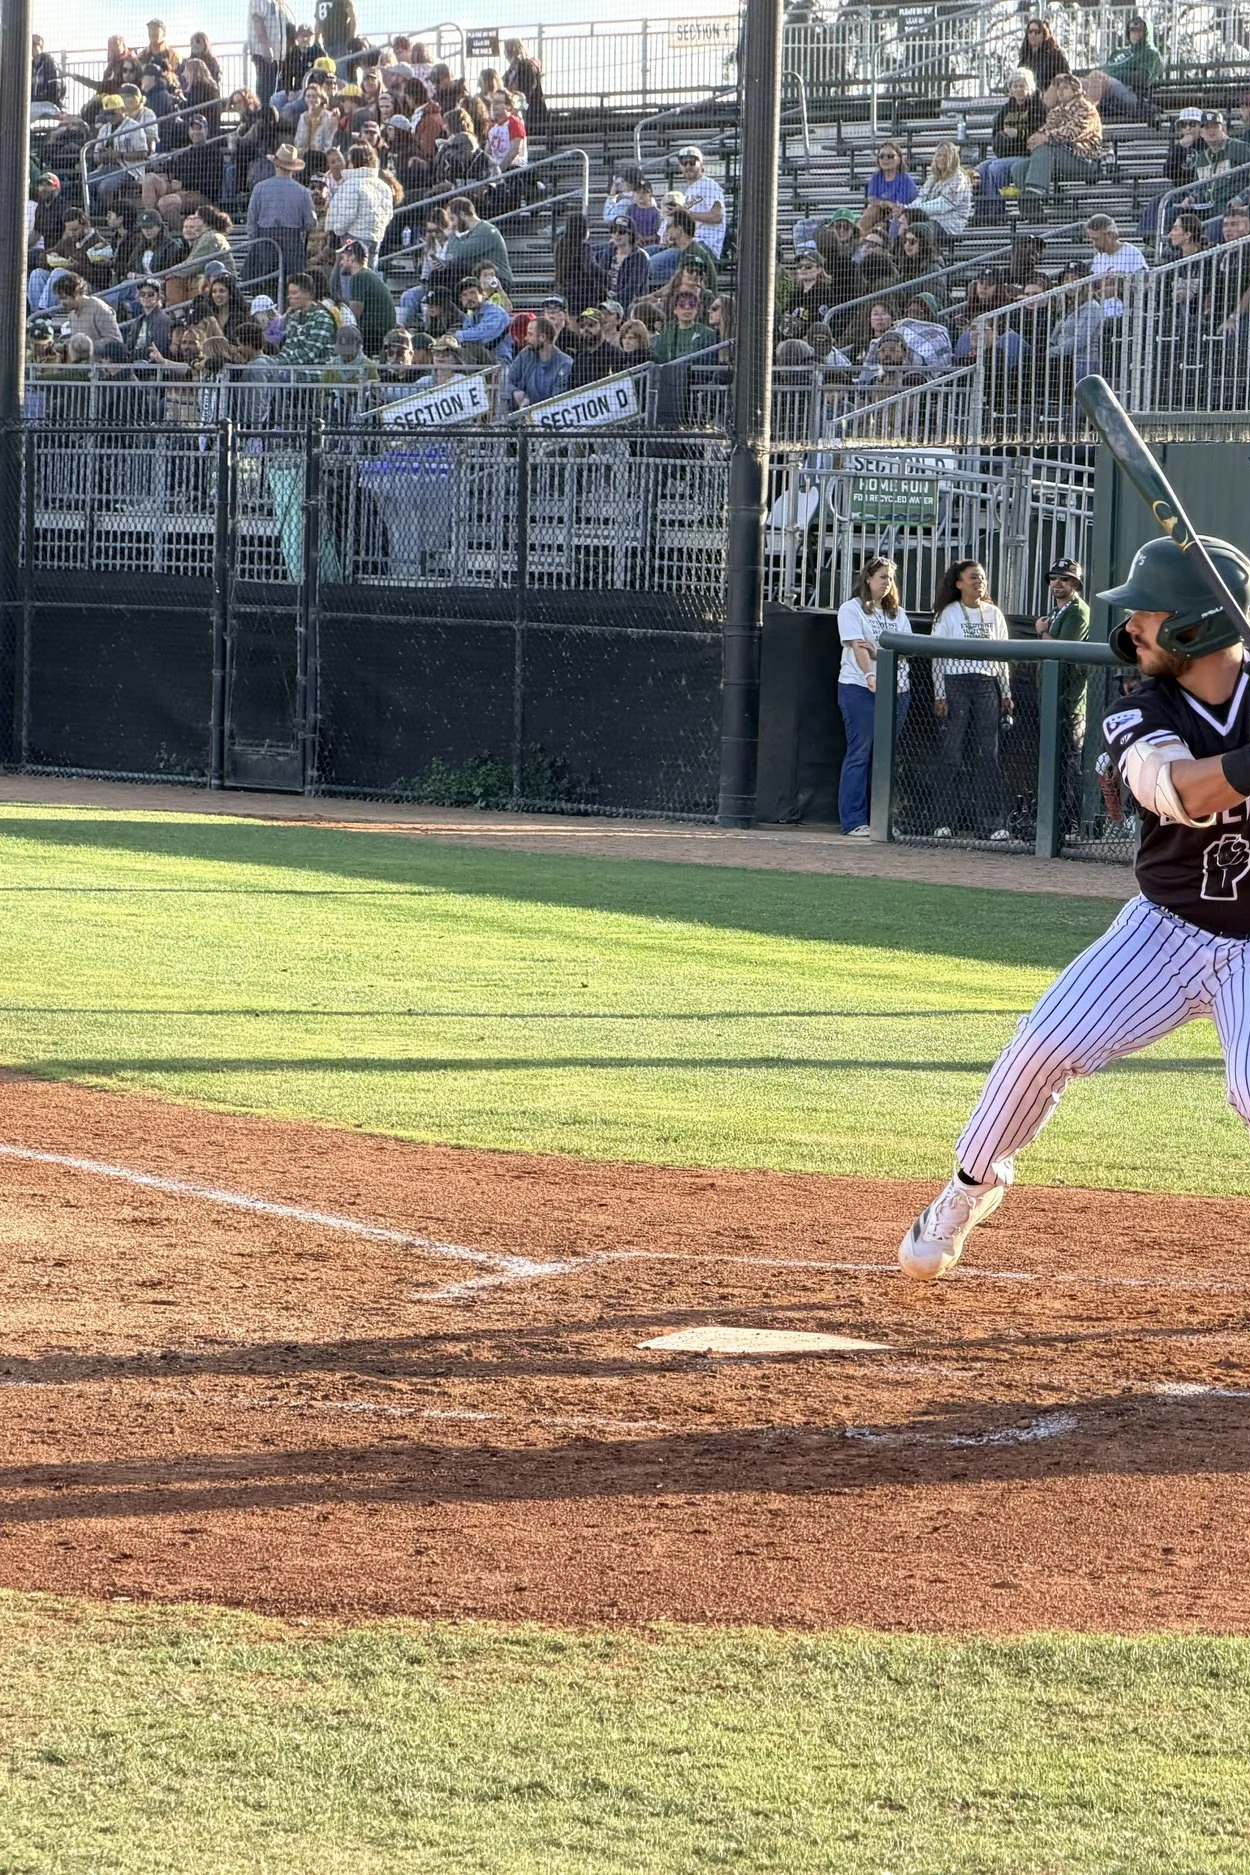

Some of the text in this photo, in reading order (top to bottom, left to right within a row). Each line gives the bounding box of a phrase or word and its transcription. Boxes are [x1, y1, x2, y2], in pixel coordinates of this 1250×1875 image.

[677, 23, 720, 41] SECTION
[394, 387, 480, 430] SECTION E
[541, 389, 628, 430] SECTION D
[858, 478, 929, 494] HOME RUN
